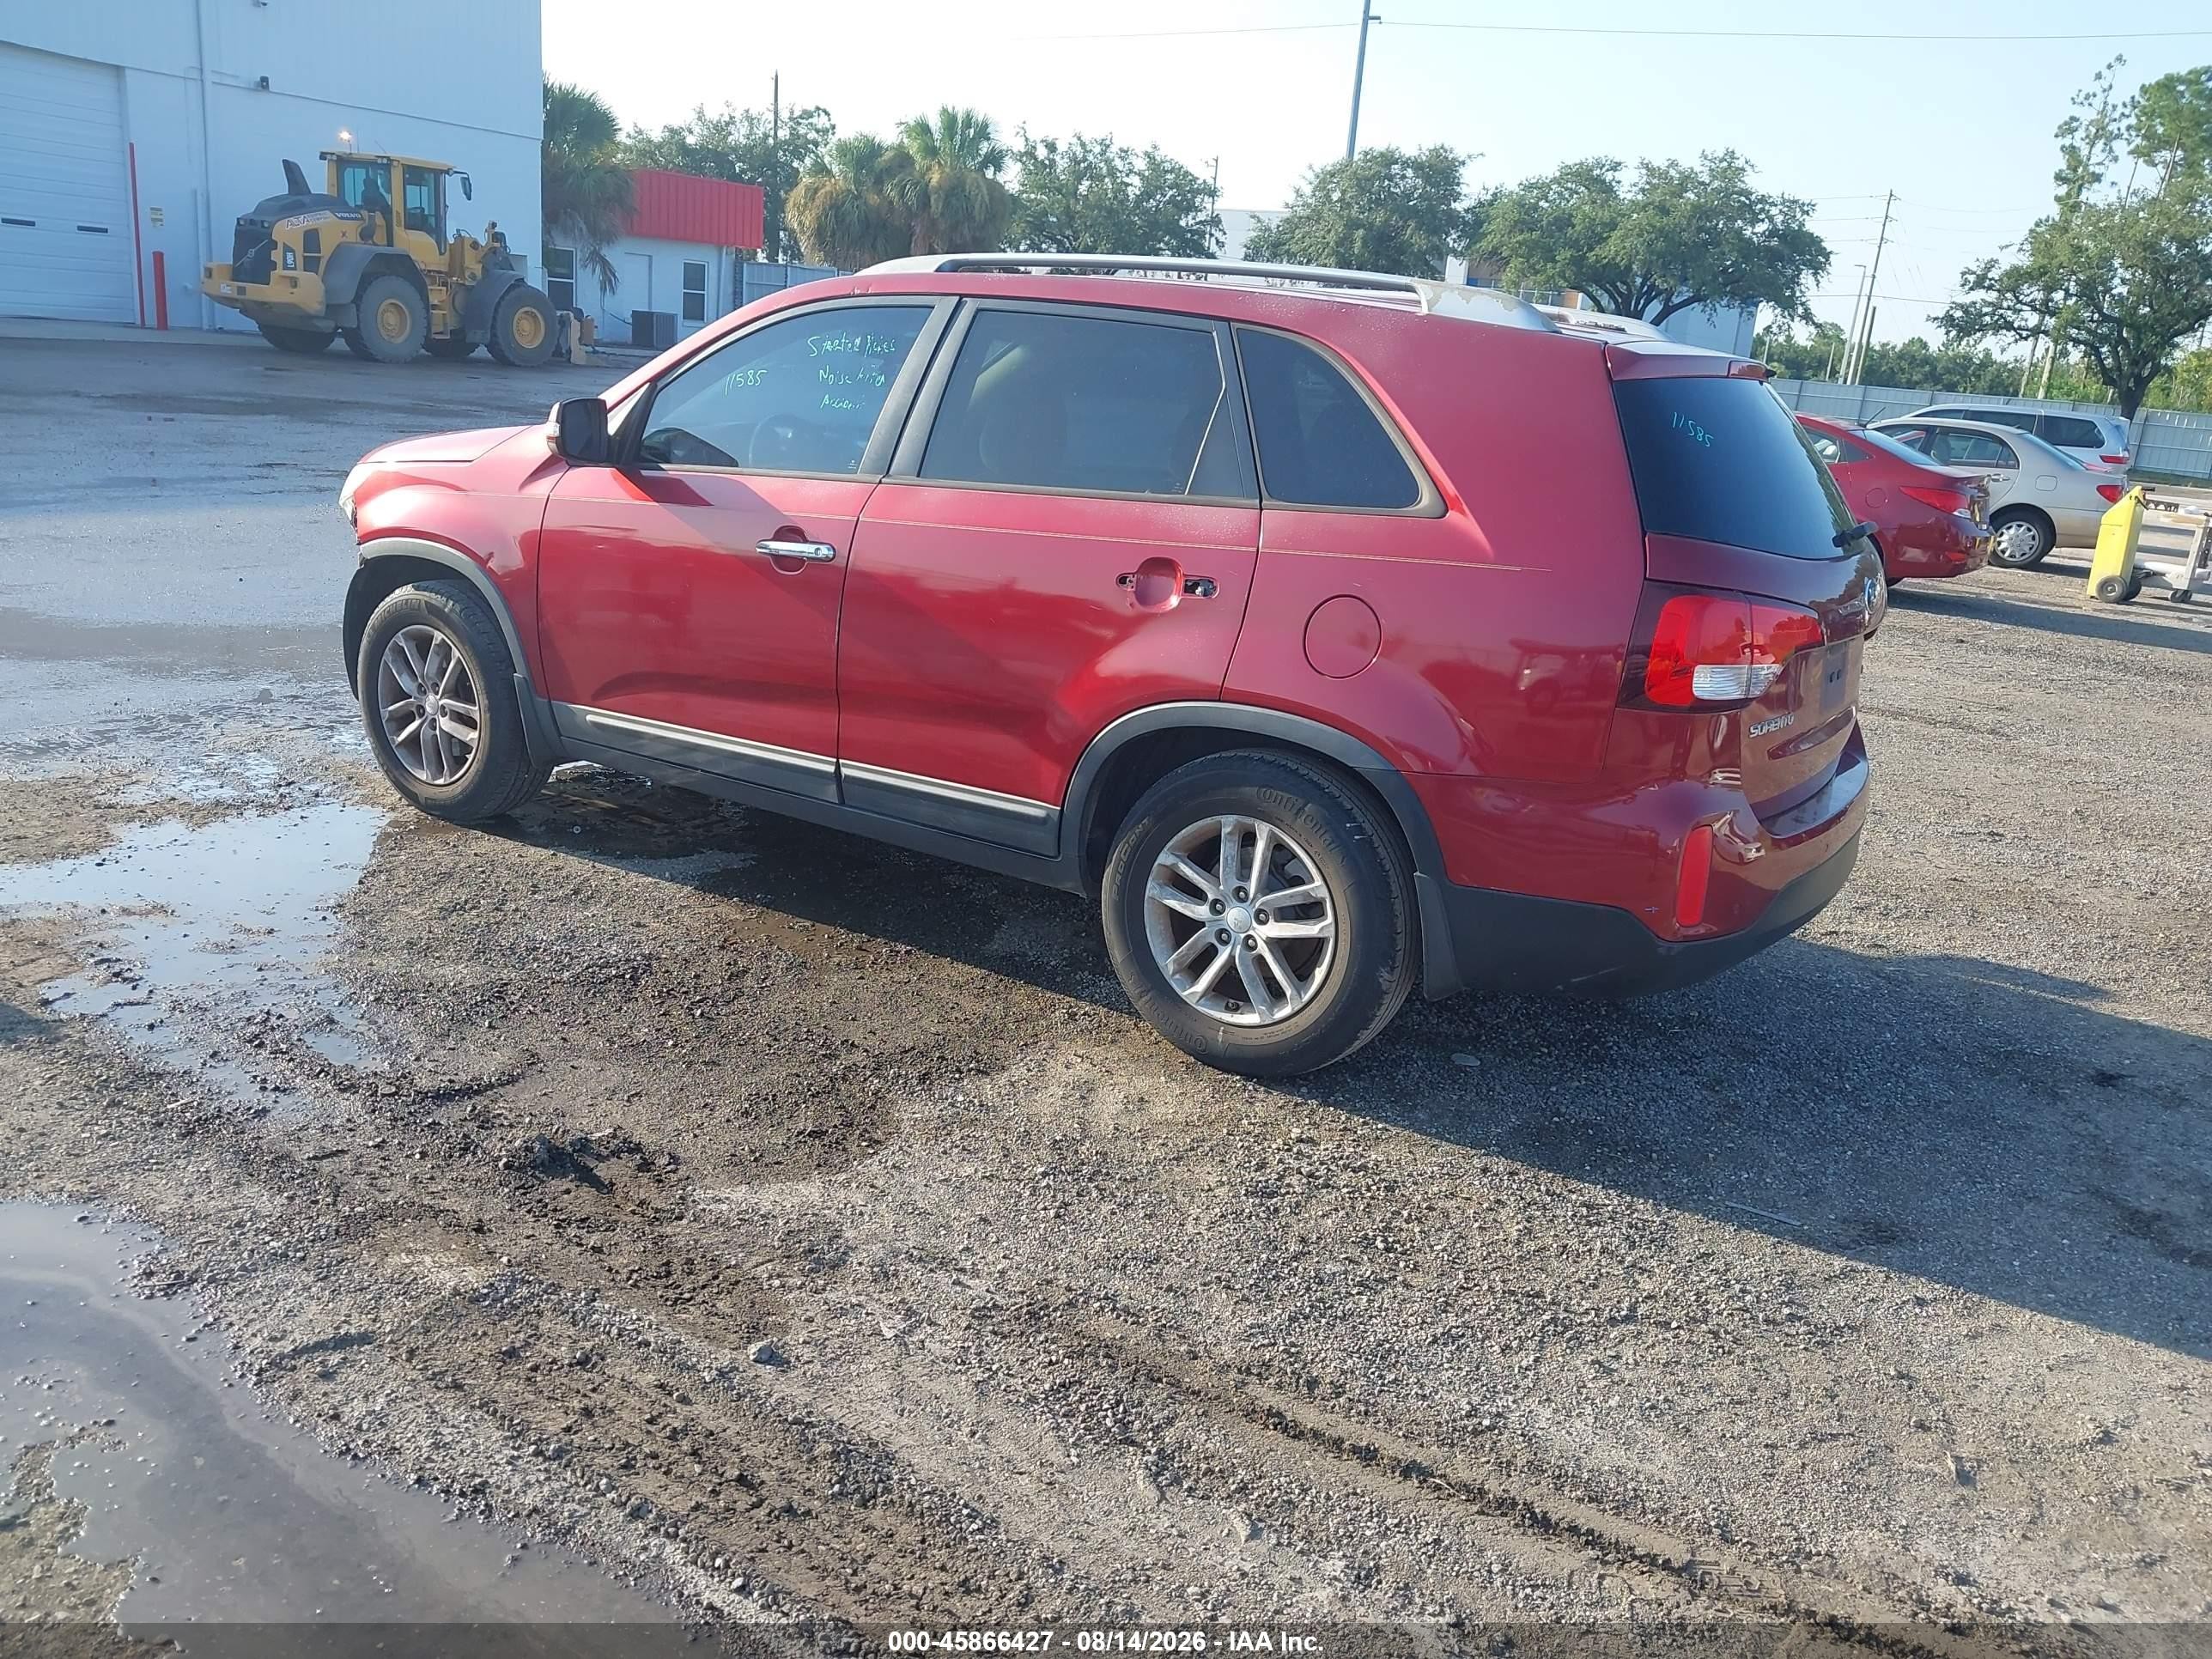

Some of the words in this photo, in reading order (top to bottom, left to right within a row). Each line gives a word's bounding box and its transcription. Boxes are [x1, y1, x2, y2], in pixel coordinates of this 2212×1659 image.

[725, 369, 768, 397] 11585
[1672, 411, 1715, 447] 11585
[1749, 712, 1796, 738] SORENTO
